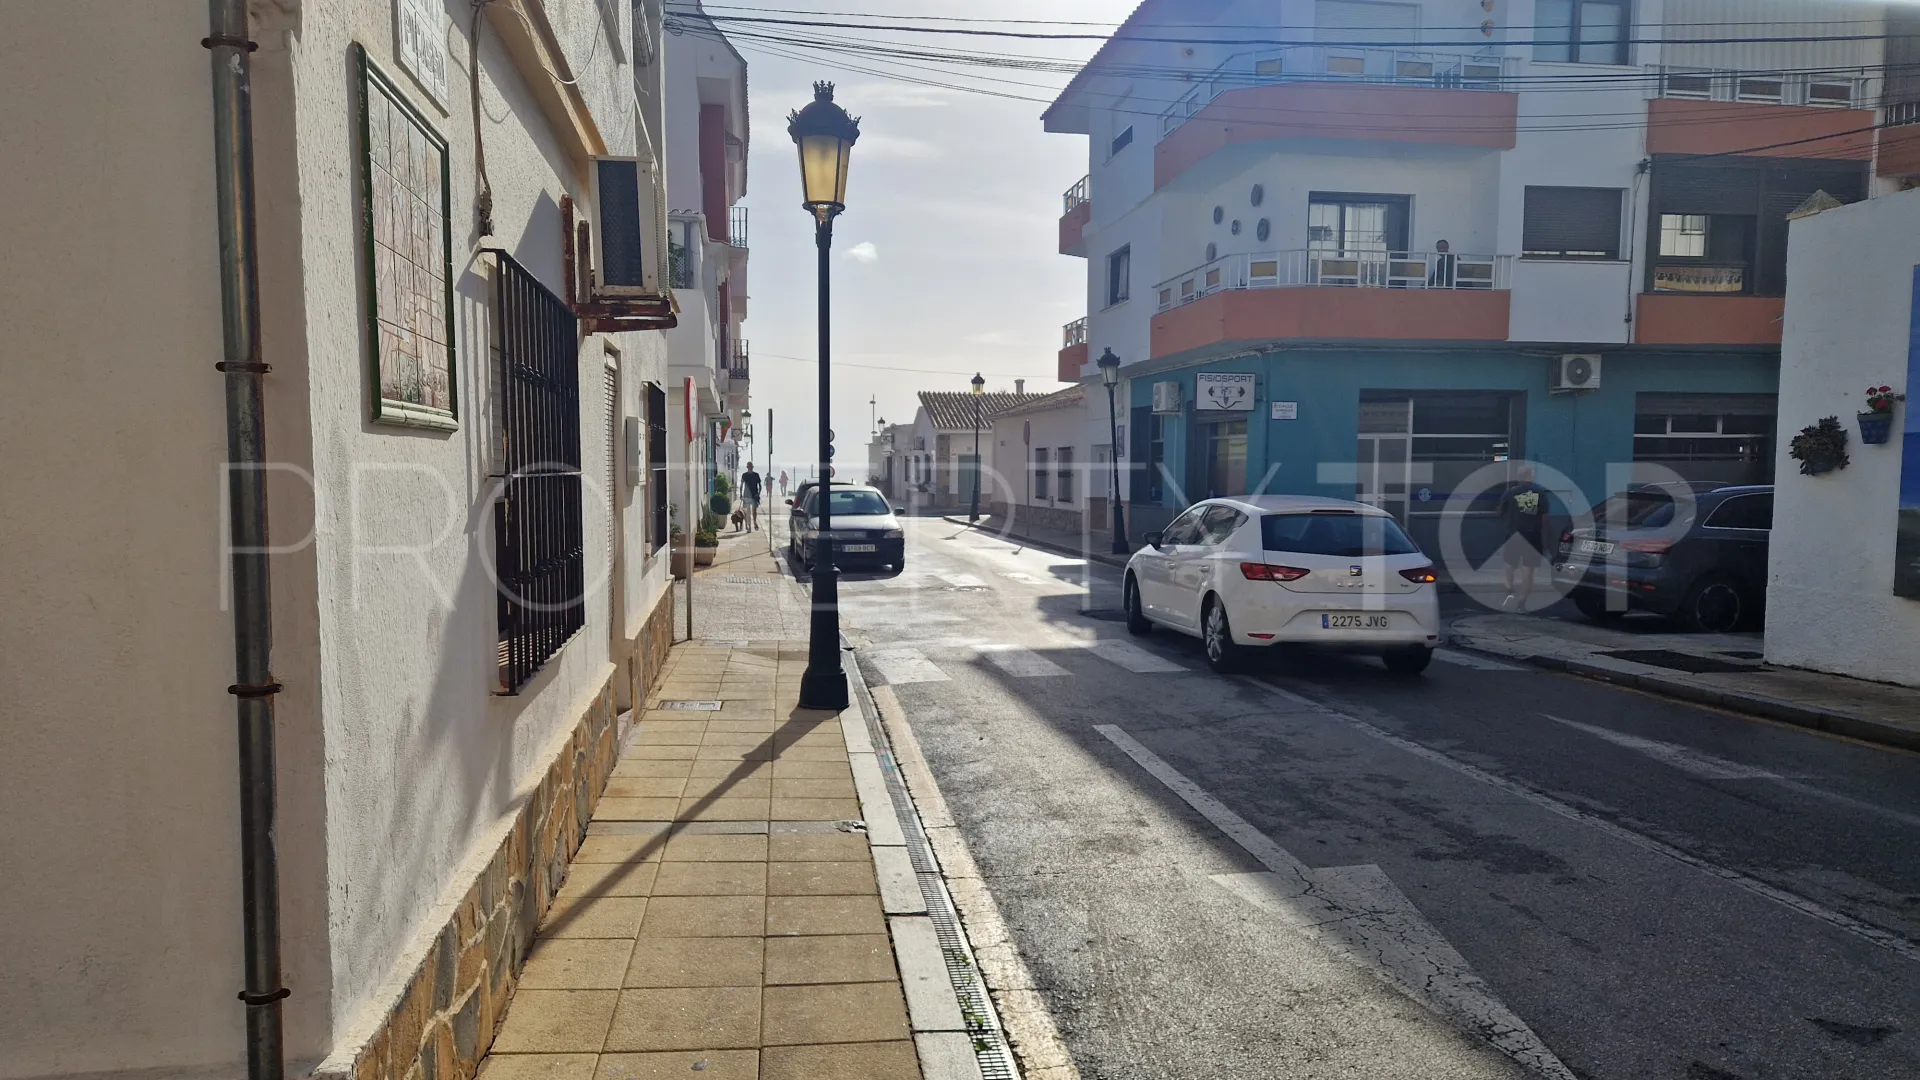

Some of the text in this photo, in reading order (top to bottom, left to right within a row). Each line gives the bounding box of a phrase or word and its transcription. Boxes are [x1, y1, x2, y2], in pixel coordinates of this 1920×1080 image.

[1198, 374, 1253, 383] FISIOSPORT
[1332, 615, 1388, 627] 2275 JVG
